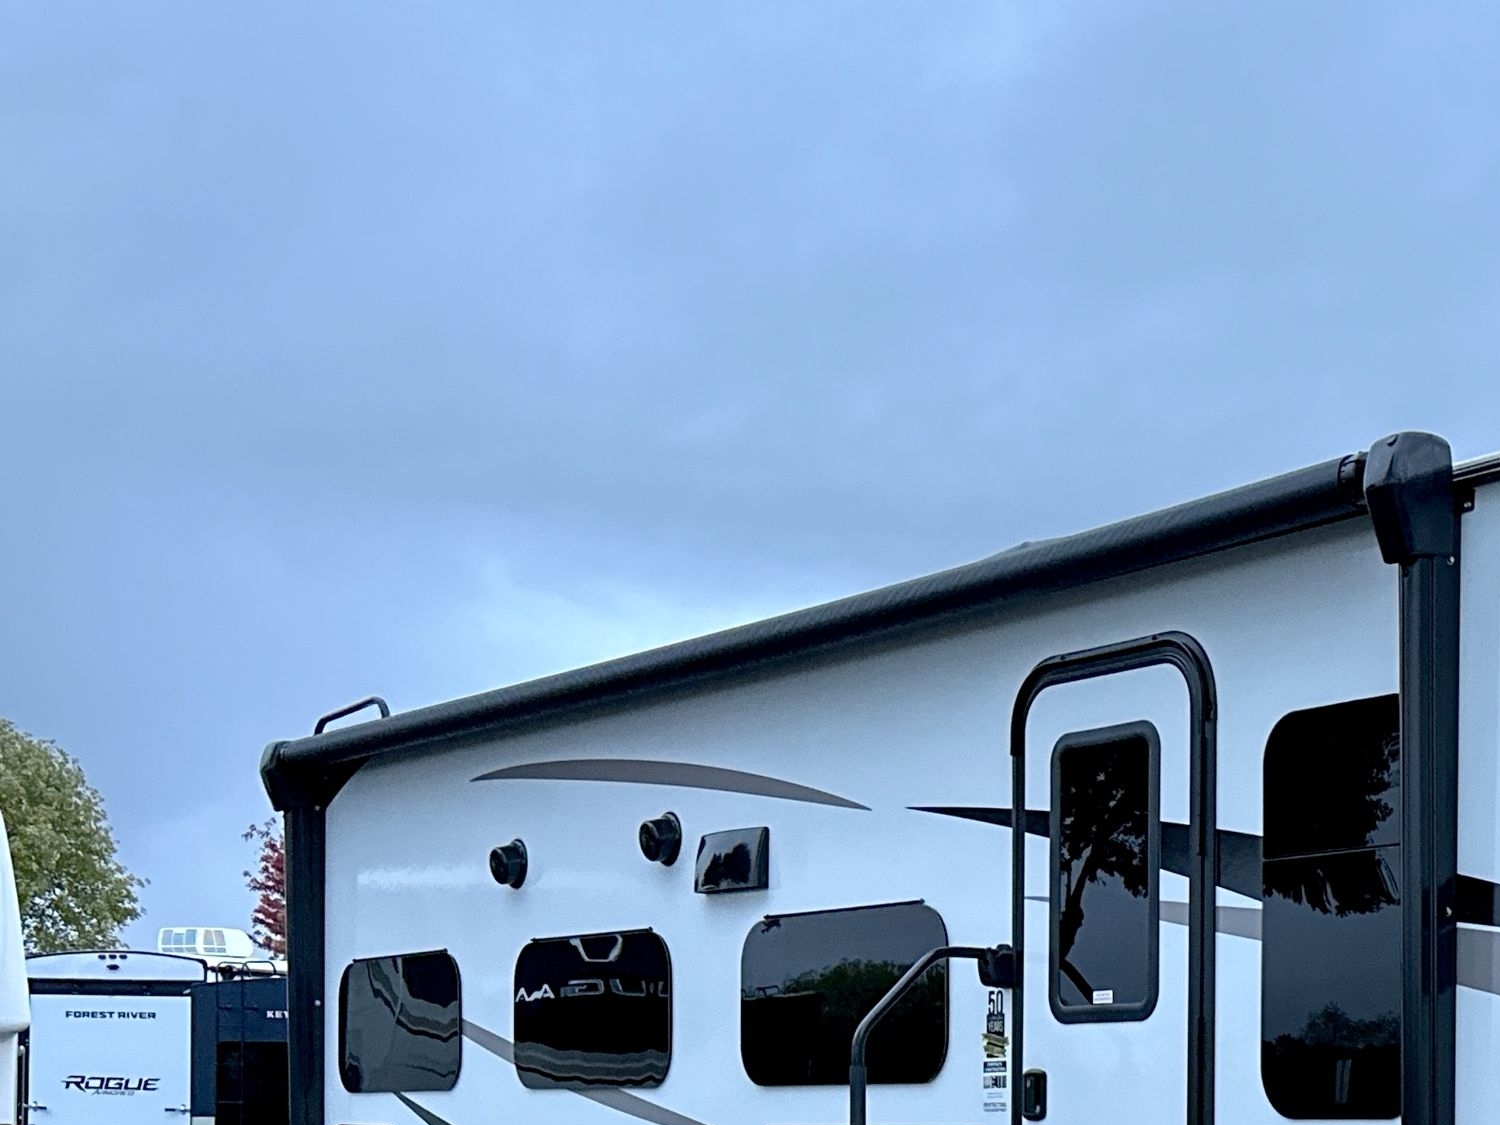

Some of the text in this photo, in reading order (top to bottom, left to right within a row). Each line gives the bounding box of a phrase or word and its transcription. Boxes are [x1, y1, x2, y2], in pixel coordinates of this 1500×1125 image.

[987, 989, 1004, 1015] 50
[65, 1010, 157, 1019] FOREST RIVER
[62, 1075, 161, 1093] ROGUE
